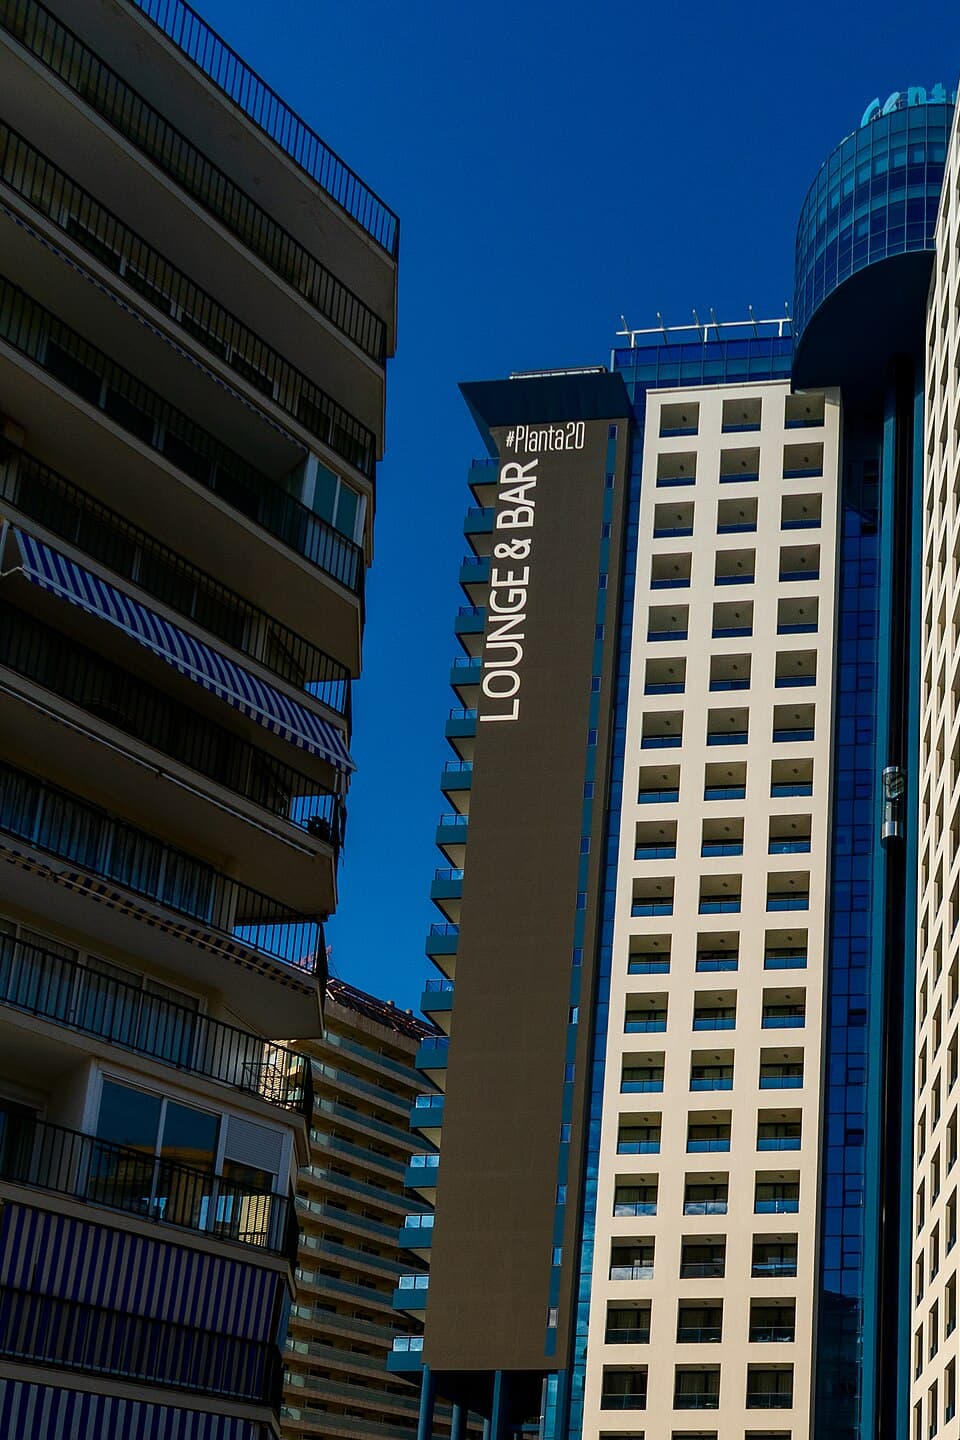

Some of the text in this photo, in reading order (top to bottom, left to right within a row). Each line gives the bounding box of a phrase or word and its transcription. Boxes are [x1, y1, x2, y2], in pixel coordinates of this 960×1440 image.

[861, 83, 957, 128] cent
[506, 421, 585, 453] #Planta20
[479, 458, 539, 722] LOUNGE & BAR
